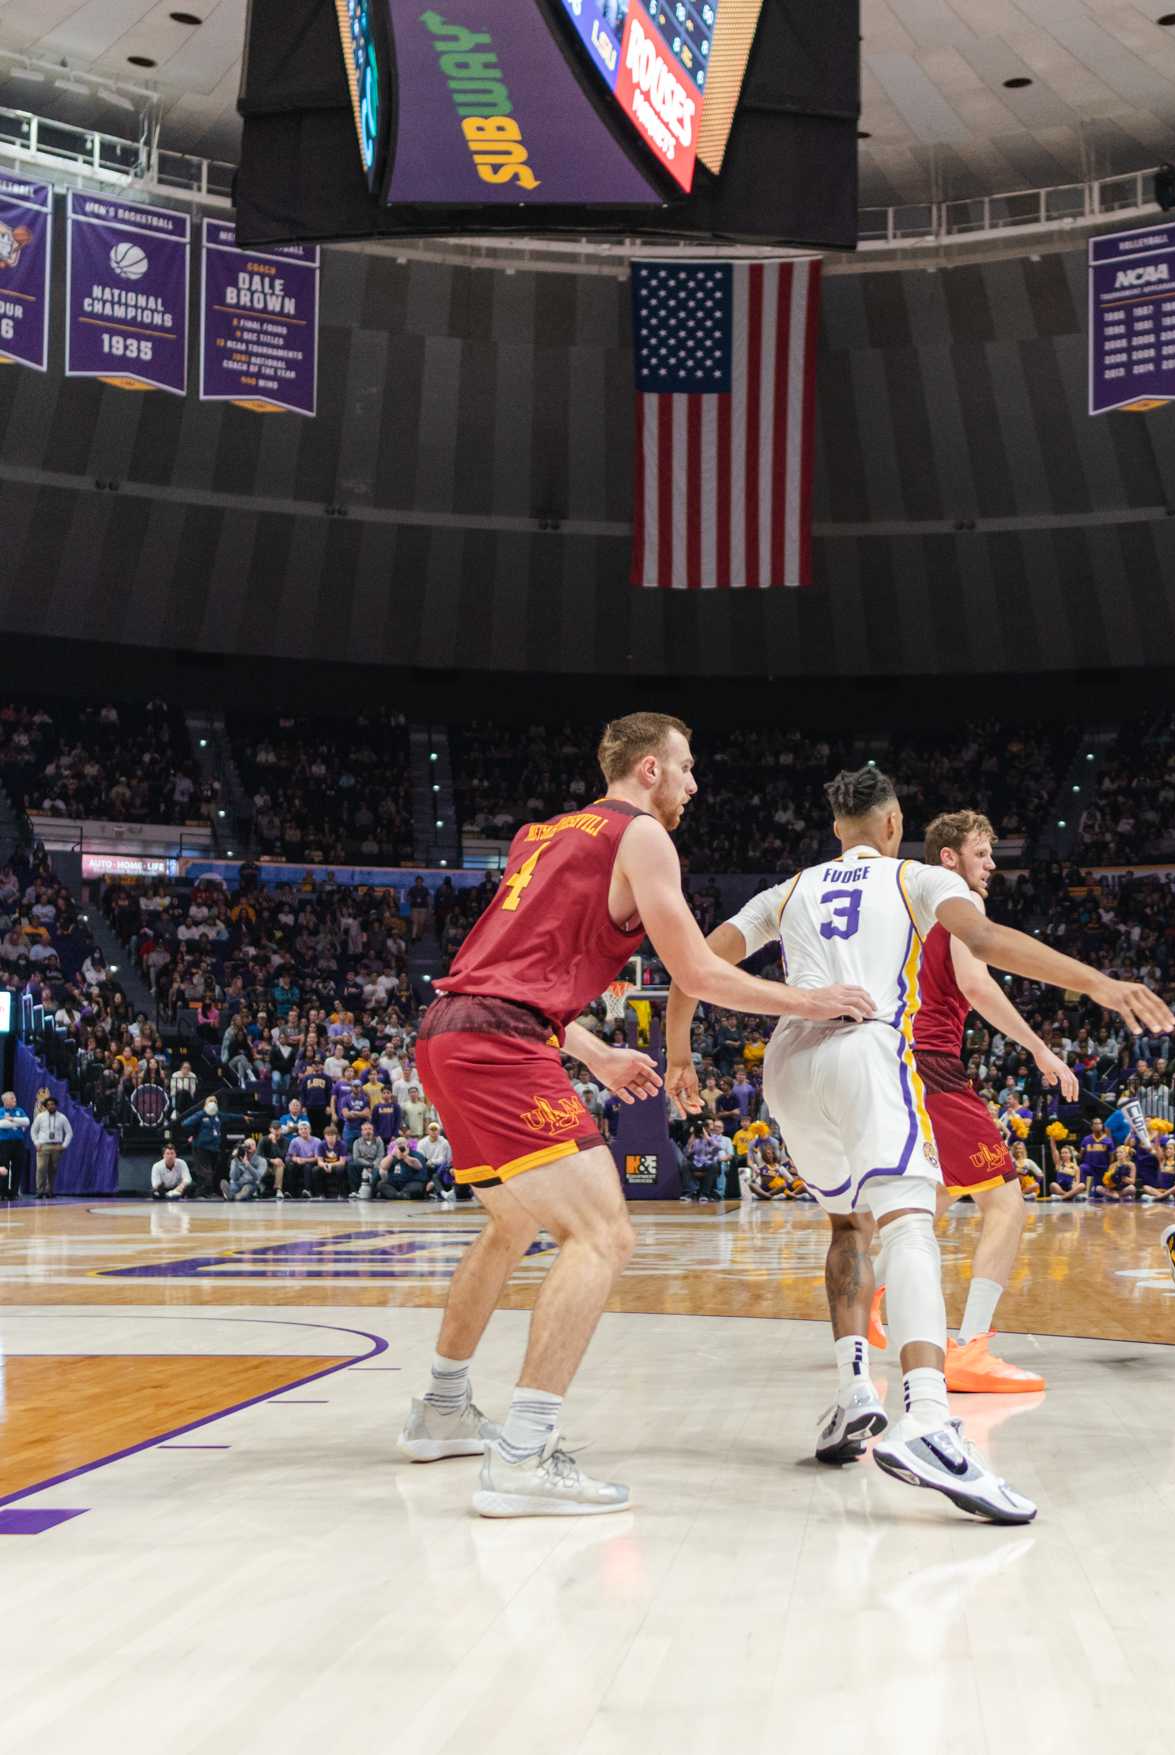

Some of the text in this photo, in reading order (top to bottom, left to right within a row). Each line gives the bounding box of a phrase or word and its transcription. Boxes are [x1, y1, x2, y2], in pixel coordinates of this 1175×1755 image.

[626, 19, 695, 147] ROUSES
[419, 10, 542, 190] SUBWAY
[238, 272, 285, 296] DALE
[1115, 263, 1169, 288] NCAA
[93, 285, 164, 311] NATIONAL
[225, 286, 296, 315] BROWN
[83, 298, 173, 327] CHAMPIONS
[101, 333, 153, 361] 1935
[502, 841, 551, 912] 4
[823, 866, 871, 884] FUDGE
[820, 888, 863, 940] 3
[626, 1155, 657, 1174] H&E
